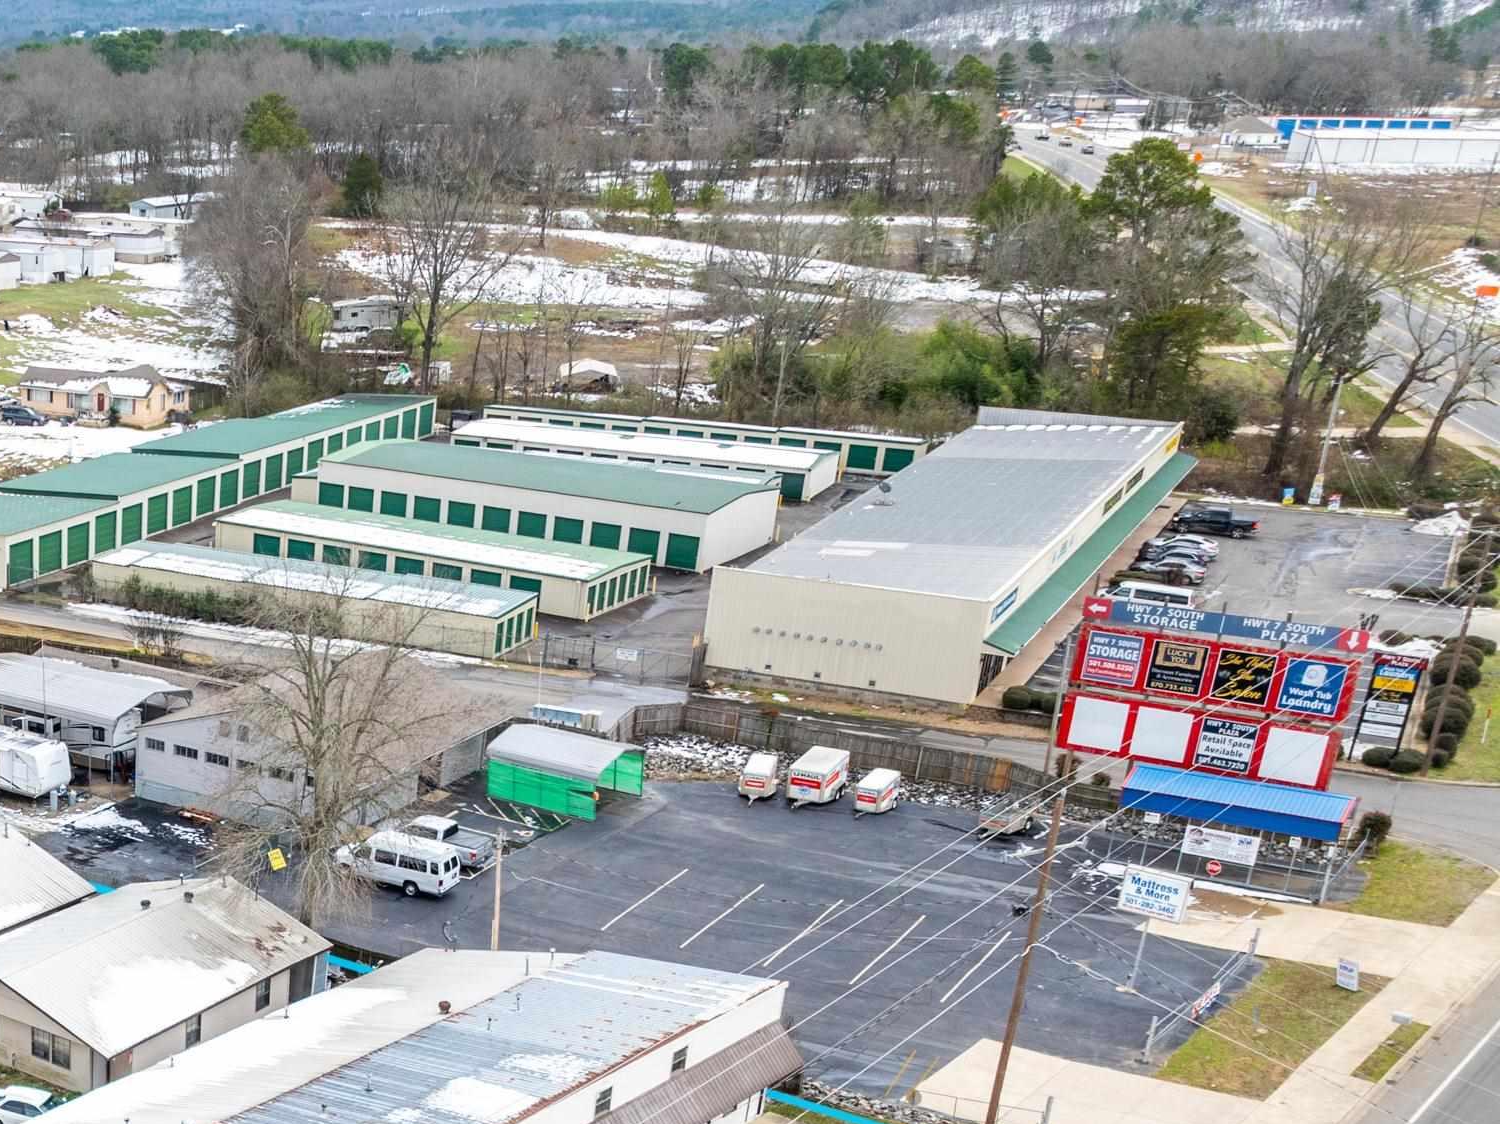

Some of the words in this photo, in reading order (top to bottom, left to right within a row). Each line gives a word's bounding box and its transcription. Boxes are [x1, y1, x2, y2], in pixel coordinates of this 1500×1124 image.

[1126, 603, 1153, 614] HWY
[1156, 607, 1163, 615] 7
[1167, 609, 1205, 621] SOUTH
[1133, 613, 1197, 630] STORAGE
[1243, 618, 1268, 629] HWY
[1273, 621, 1280, 629] 7
[1287, 623, 1326, 636] SOUTH
[1111, 638, 1117, 646] 7
[1260, 630, 1308, 644] PLAZA
[1089, 644, 1140, 661] STORAGE
[1289, 687, 1314, 698] Wash
[1315, 690, 1332, 700] Tub
[1281, 695, 1332, 713] Laundry
[1202, 734, 1227, 746] Retail
[1204, 745, 1244, 758] Available
[1131, 875, 1180, 896] Mattress
[1145, 888, 1171, 902] More
